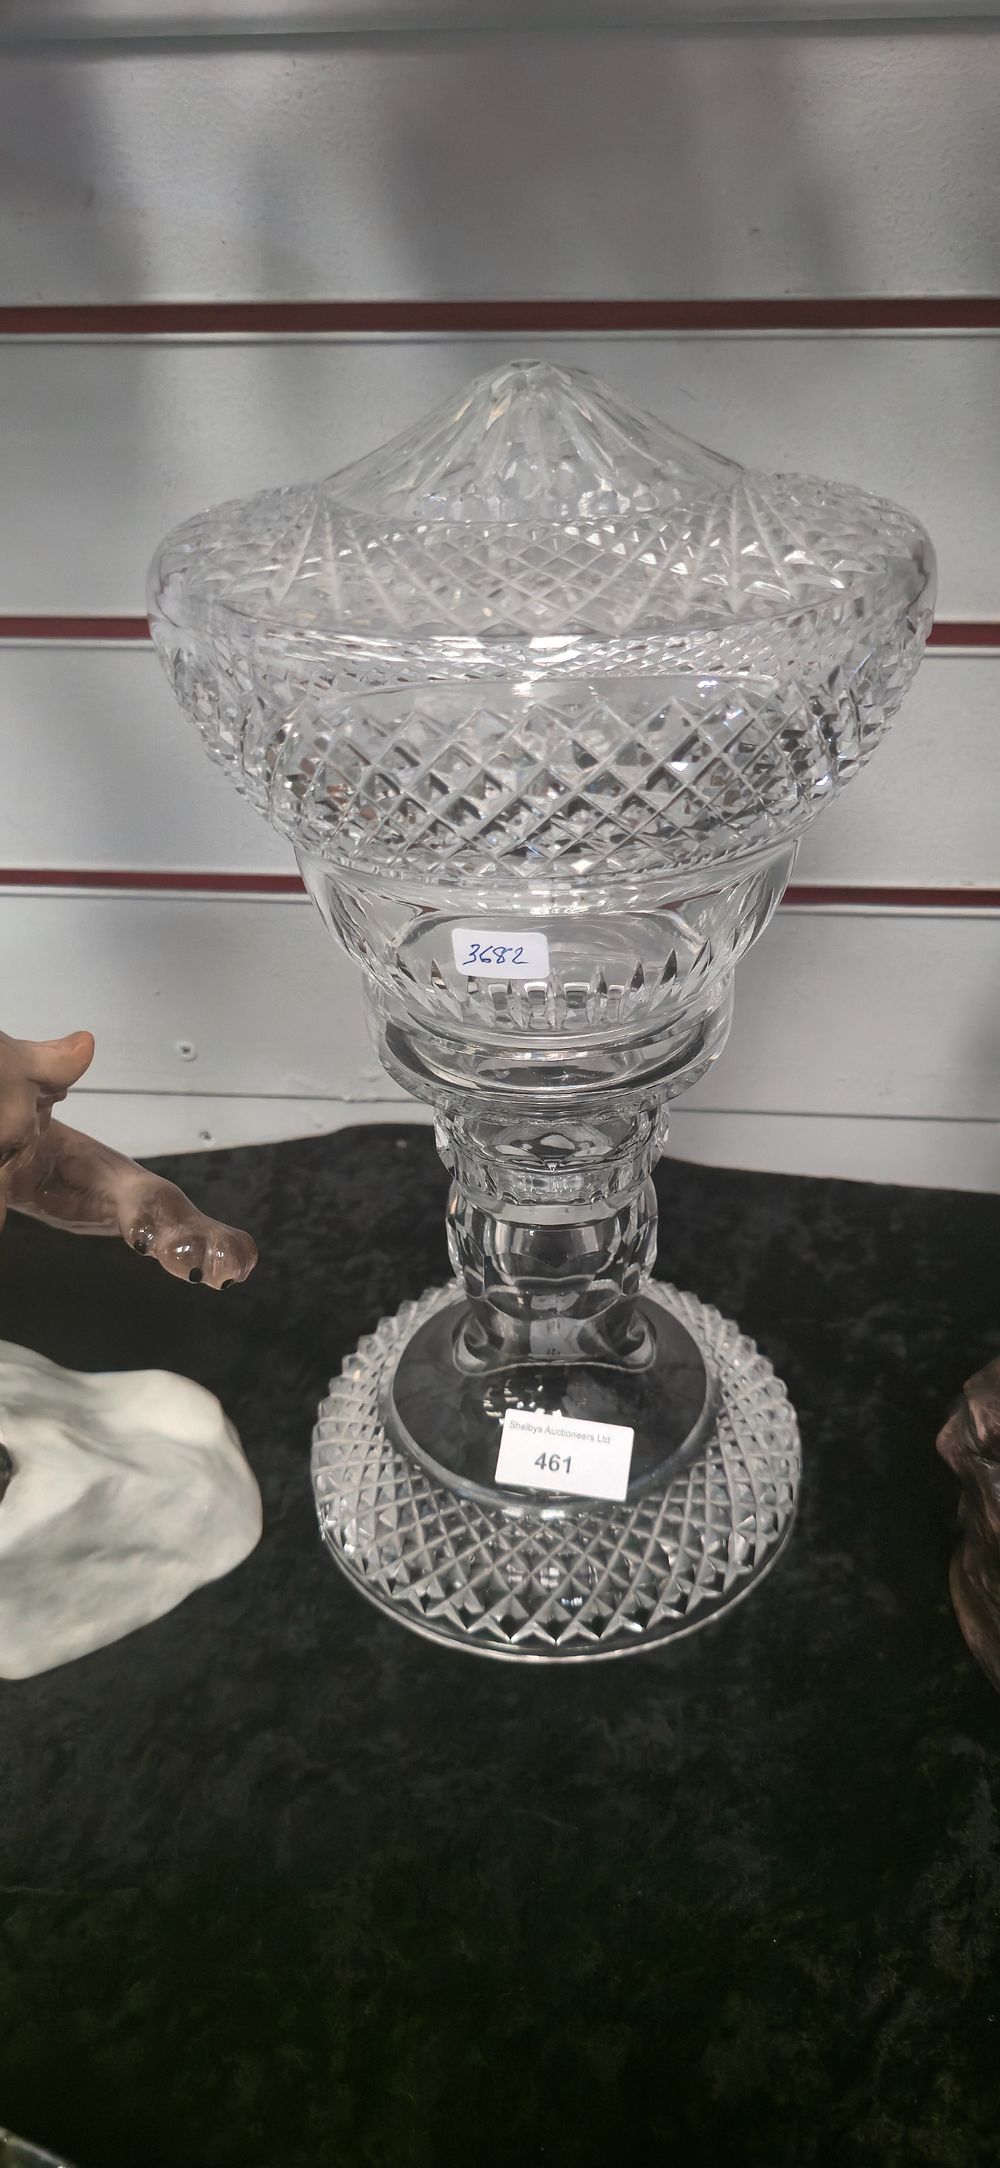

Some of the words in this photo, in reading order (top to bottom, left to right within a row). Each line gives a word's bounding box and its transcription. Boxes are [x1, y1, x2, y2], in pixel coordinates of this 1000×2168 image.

[462, 944, 529, 965] 3682
[508, 1419, 543, 1434] Shelbys
[544, 1425, 595, 1442] Auctioneers
[597, 1433, 611, 1444] Ltd
[534, 1452, 572, 1474] 461
